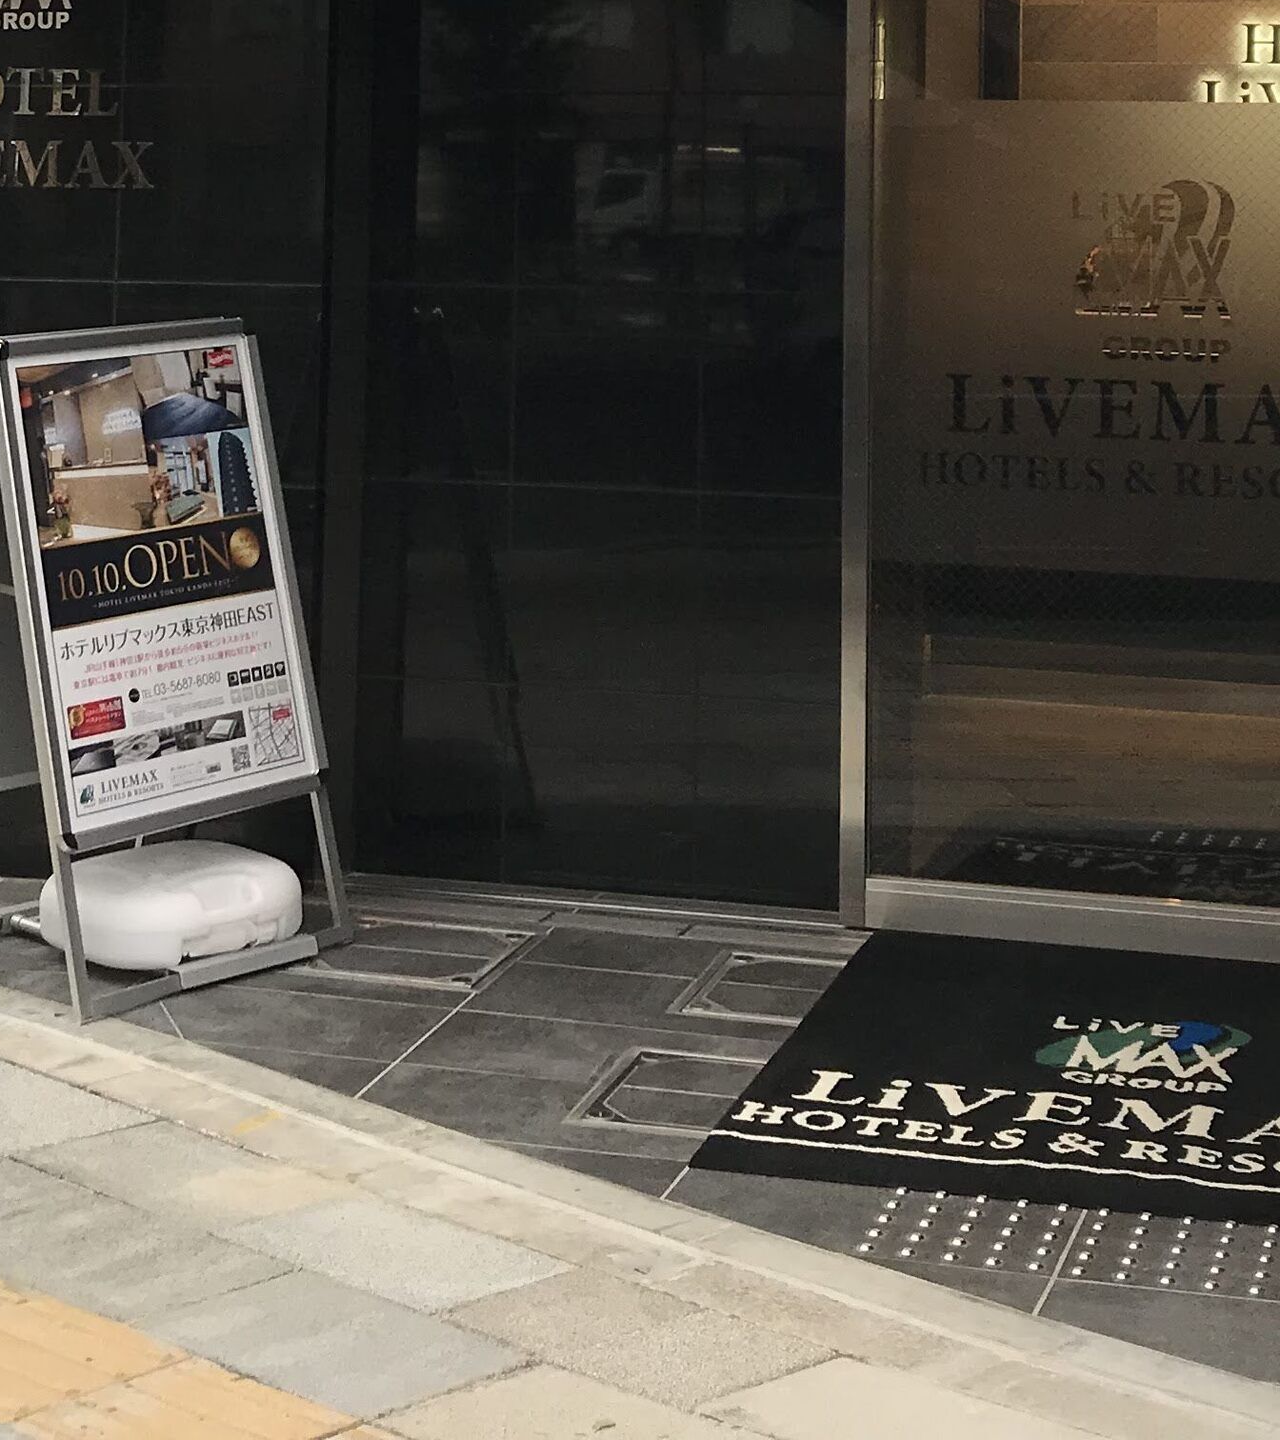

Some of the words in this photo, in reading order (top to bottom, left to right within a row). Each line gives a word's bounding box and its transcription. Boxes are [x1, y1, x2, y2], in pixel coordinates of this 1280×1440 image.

[1102, 335, 1231, 362] GROUP
[921, 452, 1106, 494] HOTELS
[1124, 462, 1158, 496] &
[1053, 1015, 1181, 1038] LiVE
[1064, 1035, 1238, 1083] MAX
[1060, 1071, 1227, 1093] GROUP
[732, 1100, 1025, 1150] HOTELS
[1048, 1133, 1106, 1157] &
